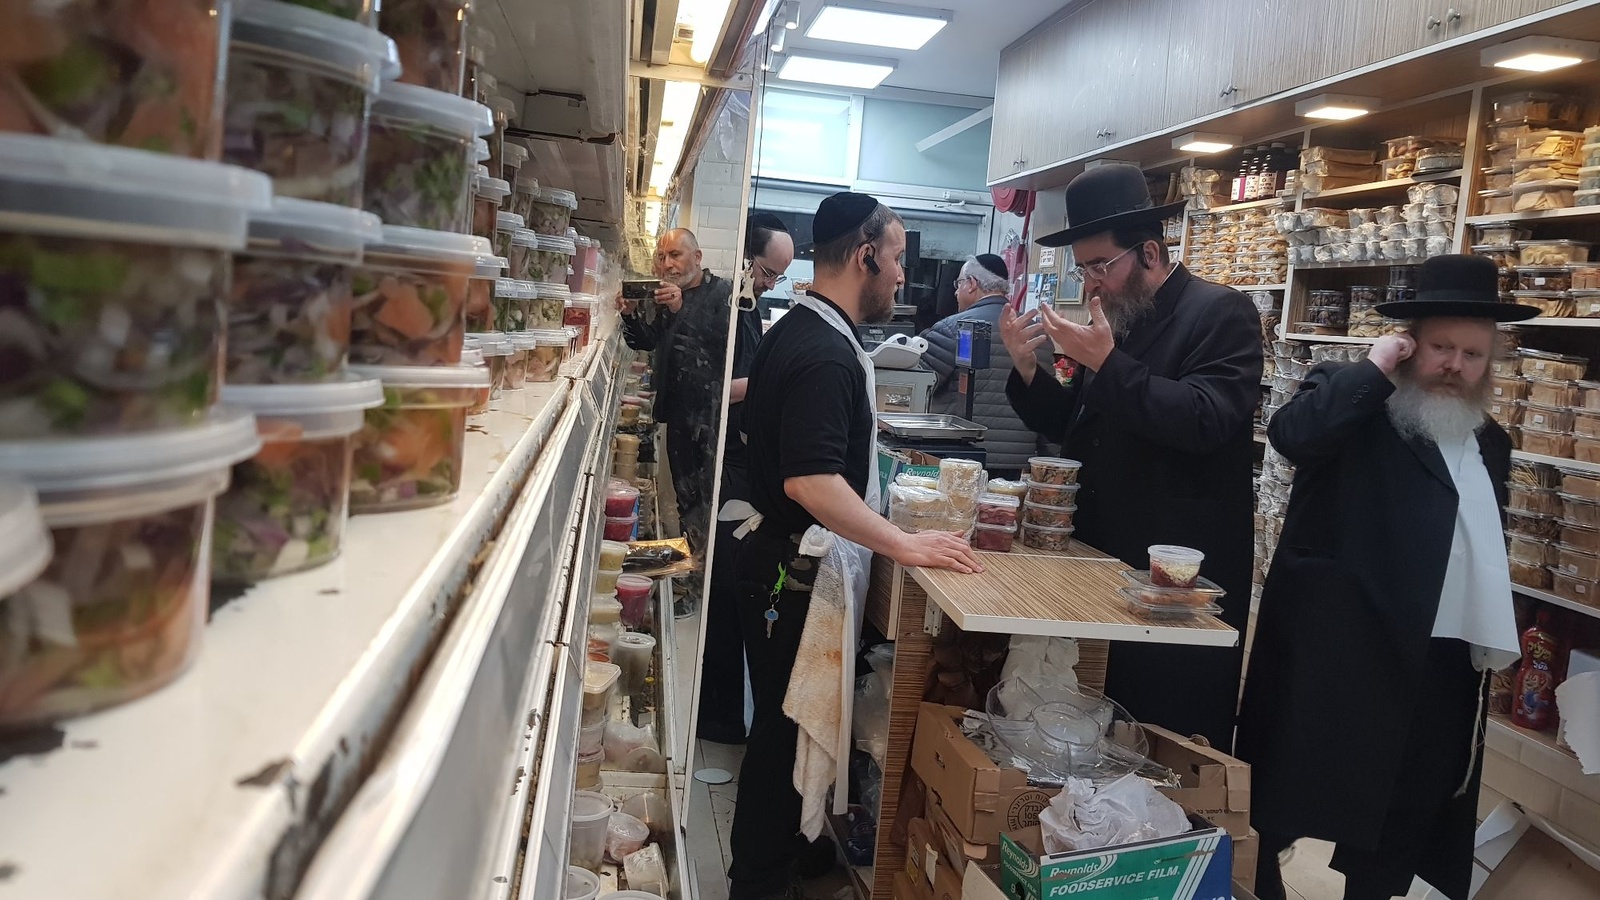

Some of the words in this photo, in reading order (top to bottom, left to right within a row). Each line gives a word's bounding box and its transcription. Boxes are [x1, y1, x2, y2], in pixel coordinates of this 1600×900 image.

[906, 467, 940, 478] Reynold
[1050, 872, 1145, 897] FOODSERVICE
[1147, 865, 1180, 880] FILM
